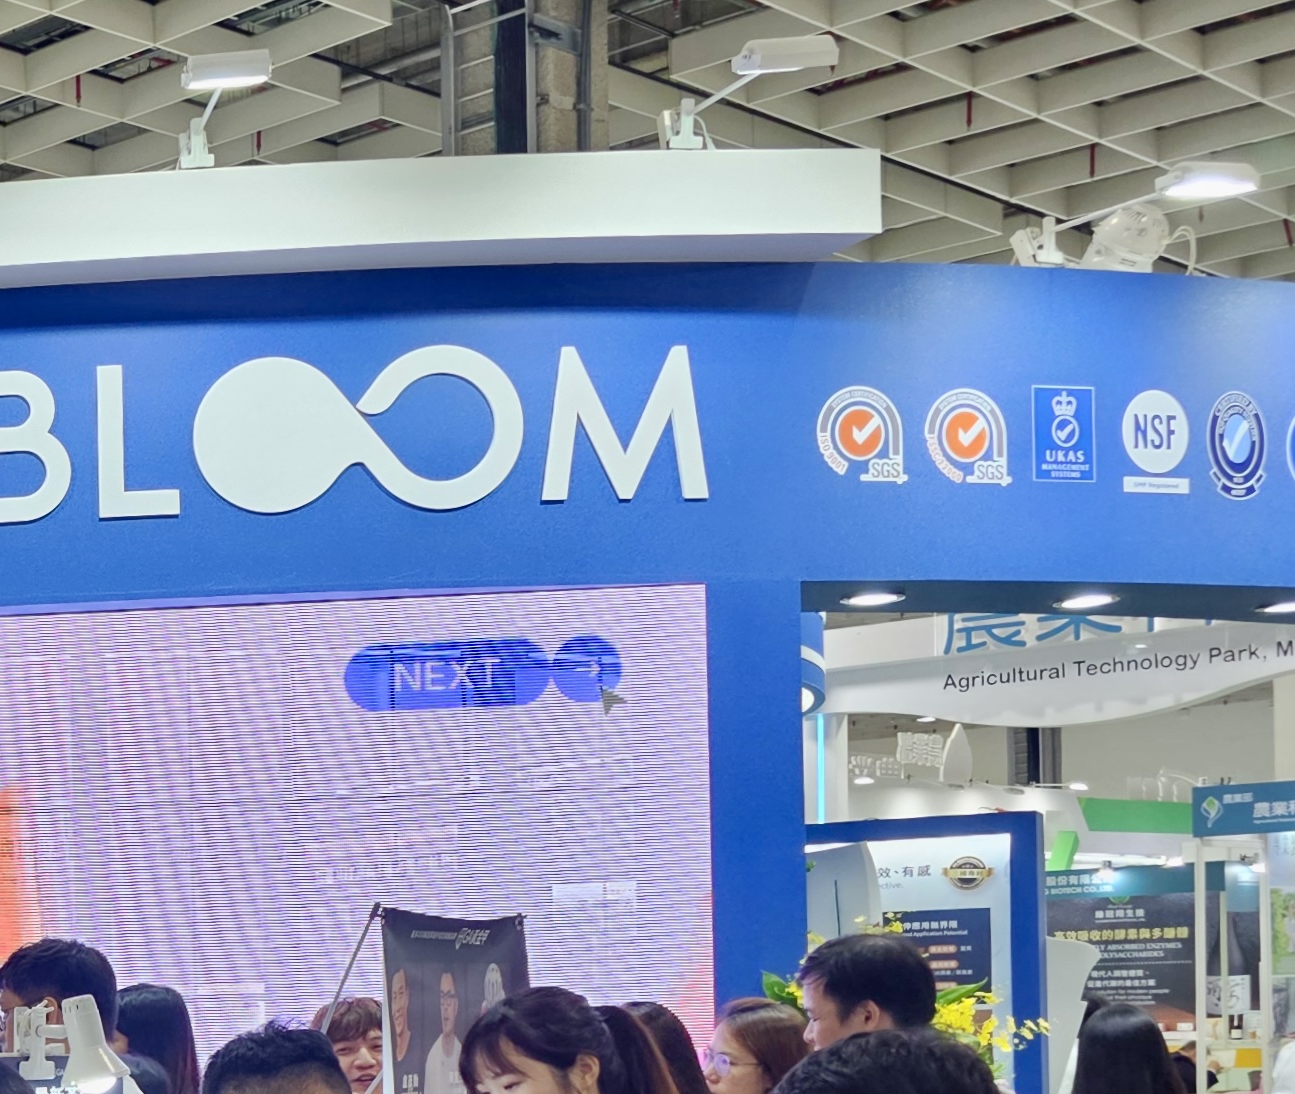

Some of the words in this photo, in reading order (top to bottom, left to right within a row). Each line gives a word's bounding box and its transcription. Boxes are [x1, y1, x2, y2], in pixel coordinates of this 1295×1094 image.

[1133, 413, 1177, 450] NSF
[1045, 450, 1085, 463] UKAS
[871, 462, 901, 479] SGS
[976, 464, 1005, 480] SGS
[393, 658, 502, 691] NEXT
[943, 661, 1066, 693] Agricultural
[1073, 651, 1202, 679] Technology
[1208, 644, 1268, 665] Park,
